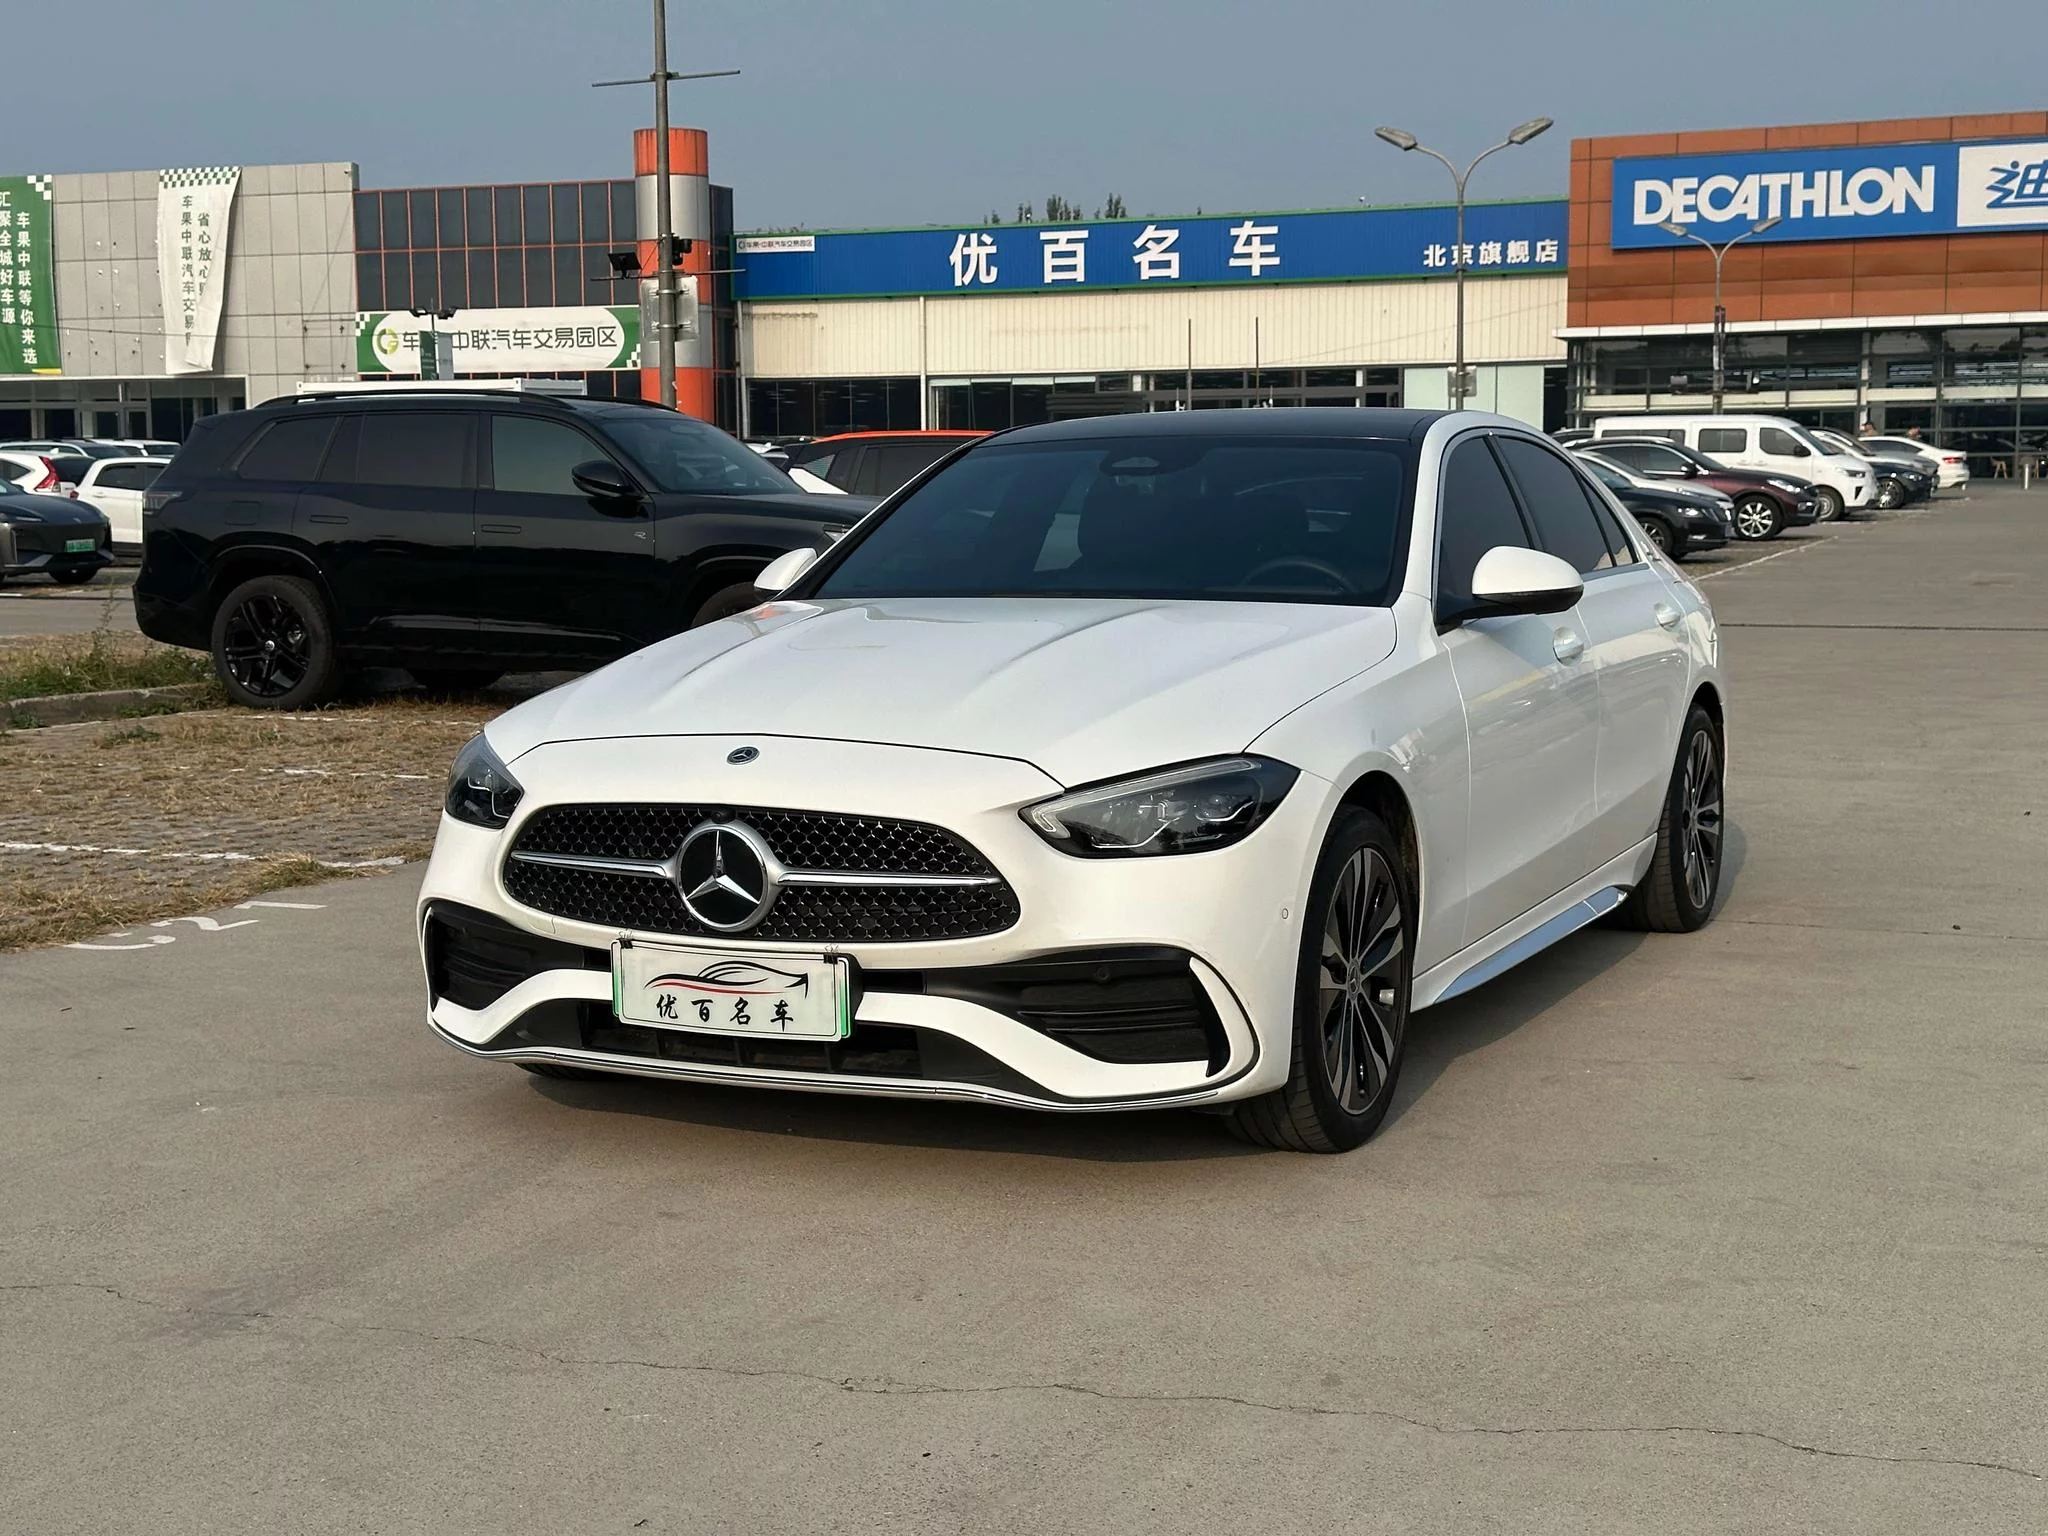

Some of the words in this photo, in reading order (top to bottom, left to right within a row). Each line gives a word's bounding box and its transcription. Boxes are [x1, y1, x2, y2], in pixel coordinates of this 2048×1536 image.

[1633, 164, 1936, 226] DECATHLON
[949, 219, 1281, 287] 优百名车
[1423, 239, 1559, 267] 北京旗舰店
[17, 211, 38, 365] 车果中联等你来选
[656, 993, 794, 1032] 优百名车
